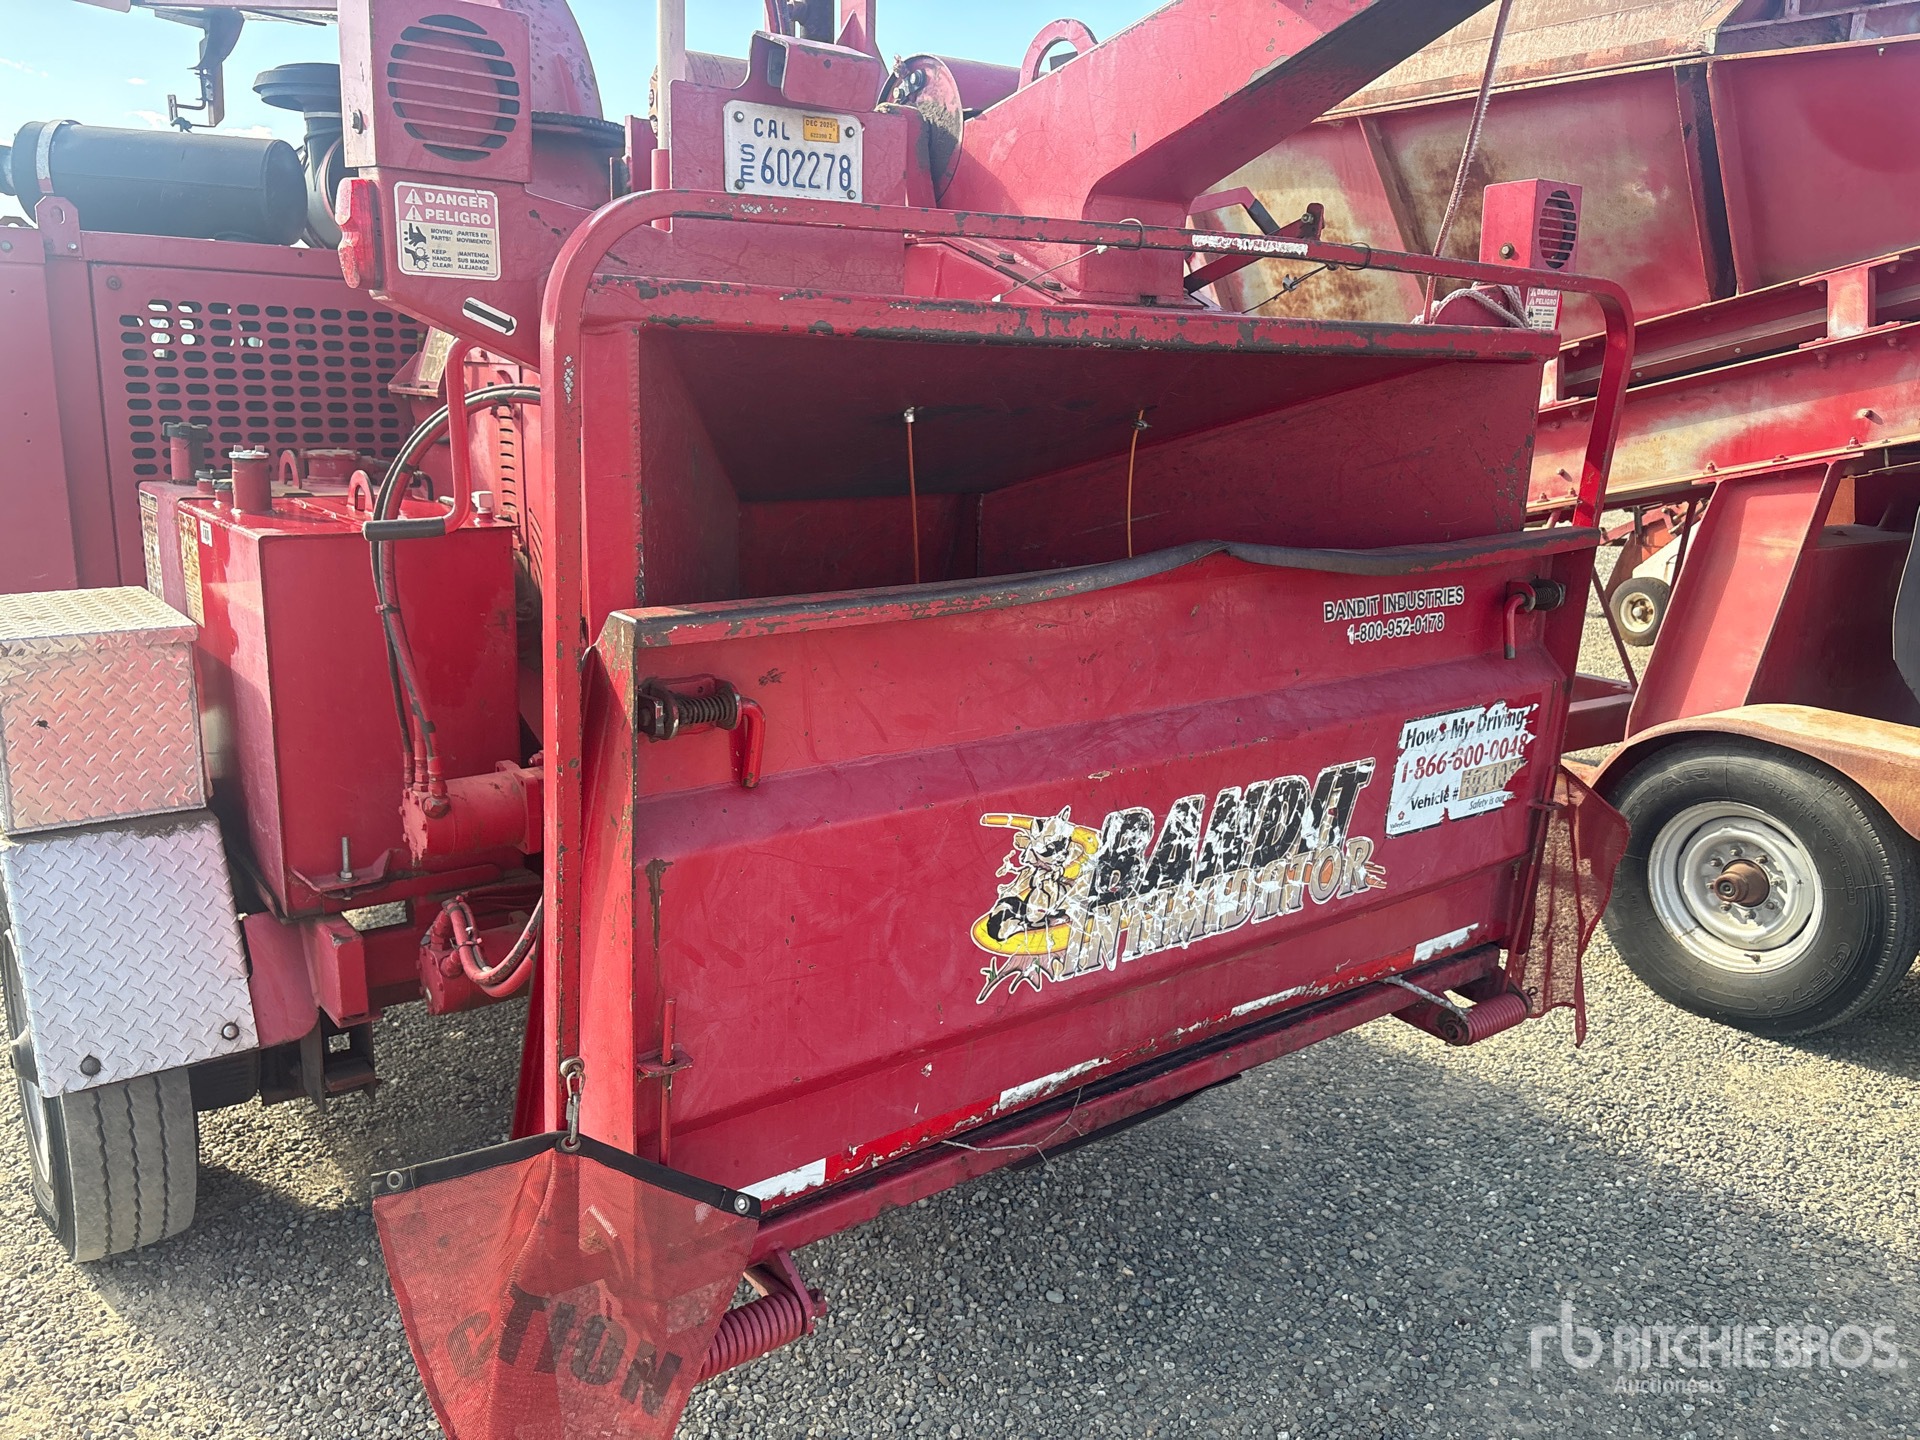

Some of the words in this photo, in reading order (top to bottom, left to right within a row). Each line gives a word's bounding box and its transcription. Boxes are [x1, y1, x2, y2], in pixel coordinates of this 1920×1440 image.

[753, 117, 790, 140] CAL
[760, 146, 852, 191] 602278
[424, 191, 489, 209] DANGER
[425, 208, 491, 226] PELIGRO
[430, 228, 453, 236] MOVING
[456, 237, 492, 246] MOVIMIENTO!
[457, 264, 489, 272] ALEJADAS!
[1324, 595, 1379, 622] BANDIT
[1383, 586, 1464, 615] INDUSTRIES
[1347, 612, 1445, 644] 1-800-952-0178
[1450, 717, 1474, 740] My
[1410, 787, 1450, 811] Vehicle
[1091, 757, 1376, 902] BANDIT
[1053, 836, 1374, 981] INTIMIDATOR
